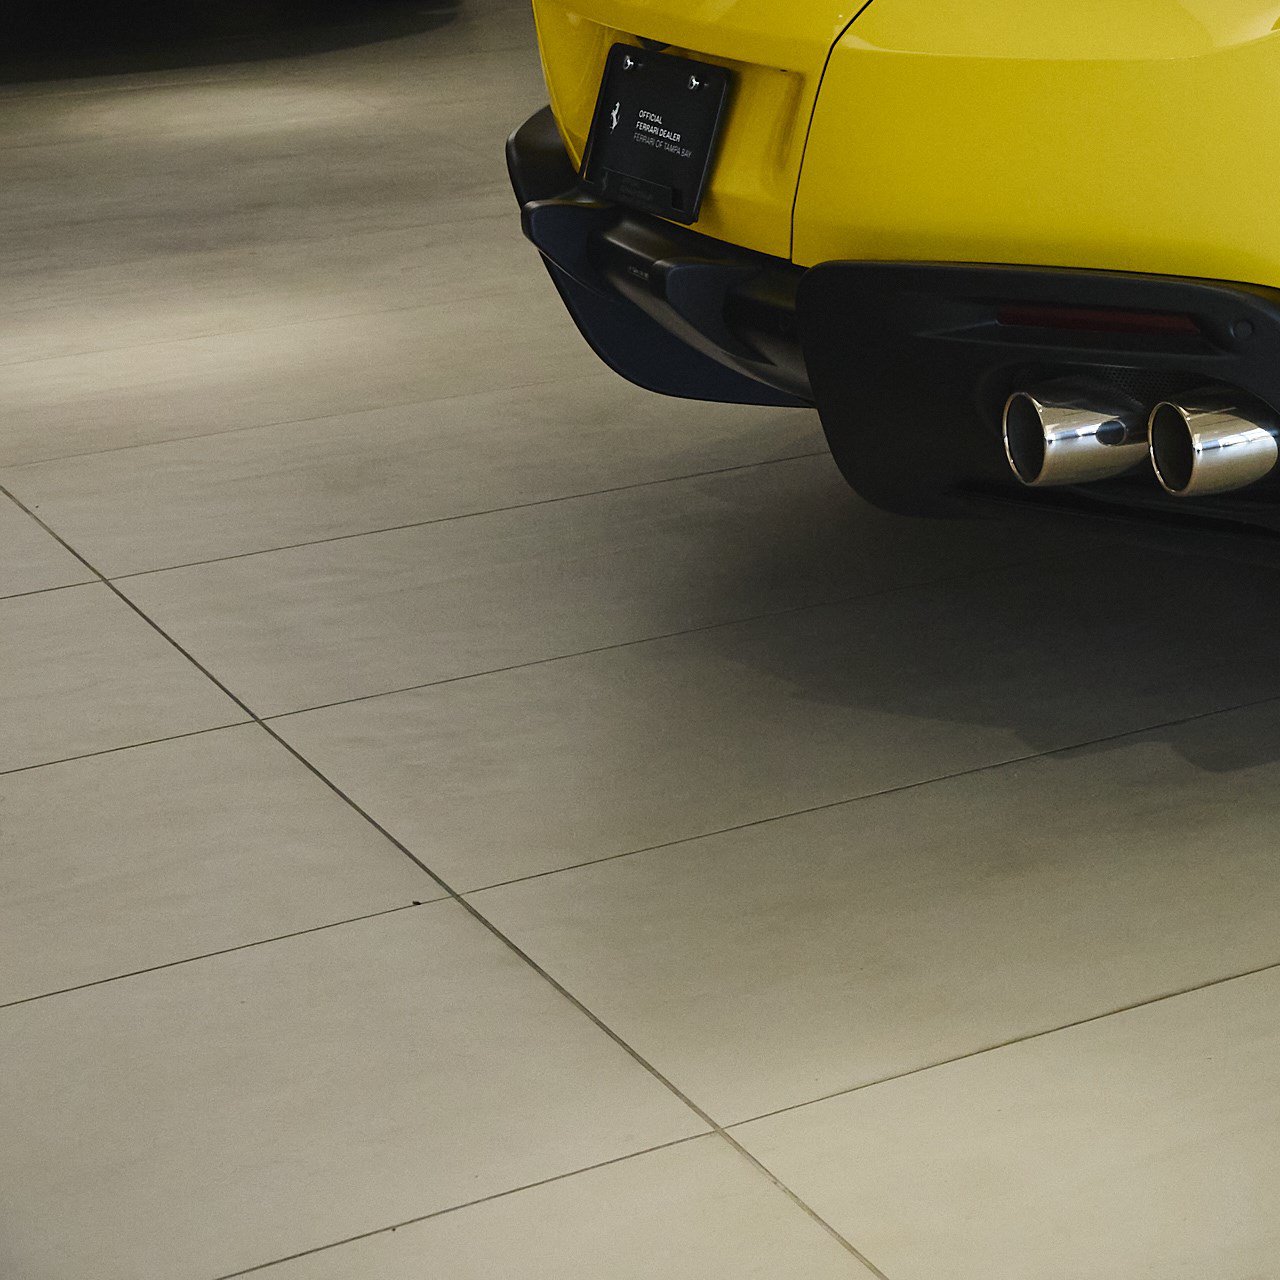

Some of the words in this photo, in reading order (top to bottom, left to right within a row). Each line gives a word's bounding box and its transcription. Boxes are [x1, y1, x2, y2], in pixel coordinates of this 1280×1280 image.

[639, 109, 663, 125] OFFICIAL
[635, 121, 659, 135] FERRARI
[658, 128, 681, 143] DEALER
[633, 132, 655, 146] FERRARI
[655, 139, 664, 148] OF
[664, 142, 681, 155] TAMPA
[681, 148, 692, 158] BAY
